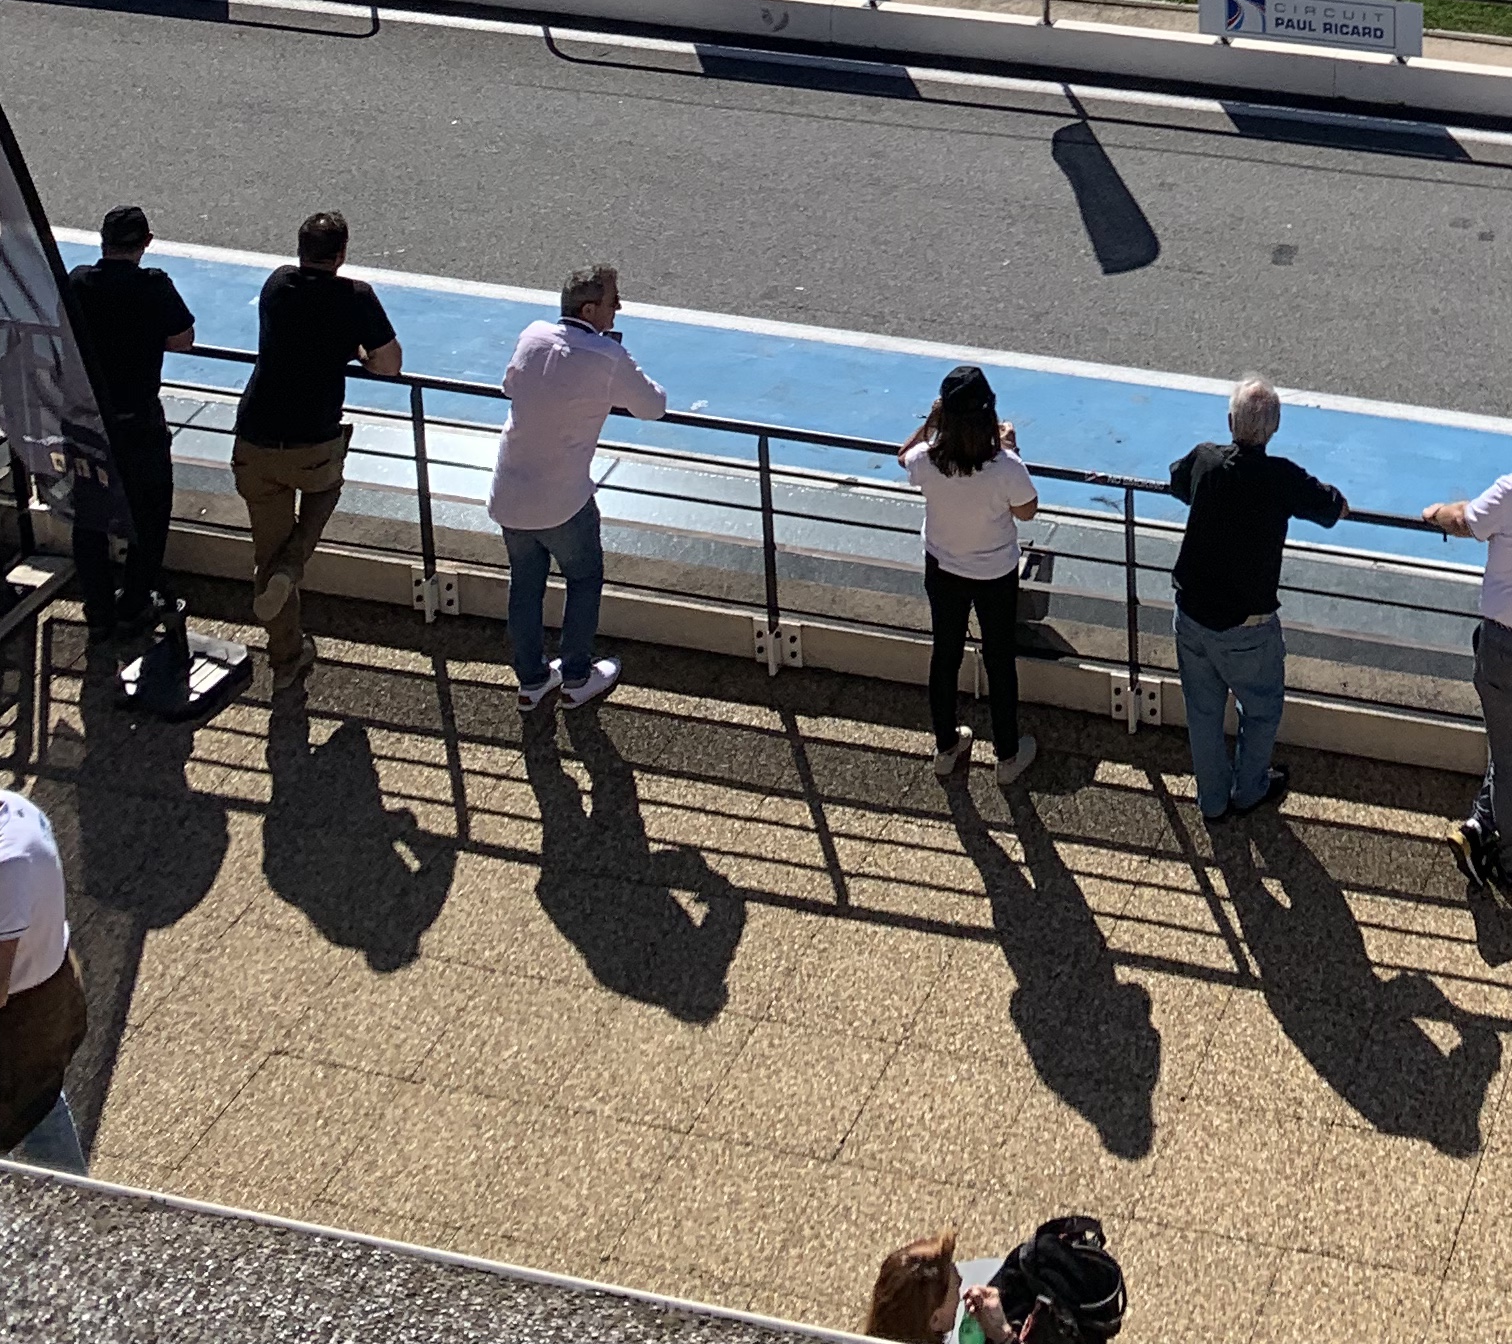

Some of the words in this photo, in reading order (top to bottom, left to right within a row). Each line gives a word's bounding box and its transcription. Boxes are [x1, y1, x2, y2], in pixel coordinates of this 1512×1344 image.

[1274, 1, 1384, 23] CIRCUIT
[1274, 16, 1316, 33] PAUL
[1323, 22, 1385, 40] RICARD
